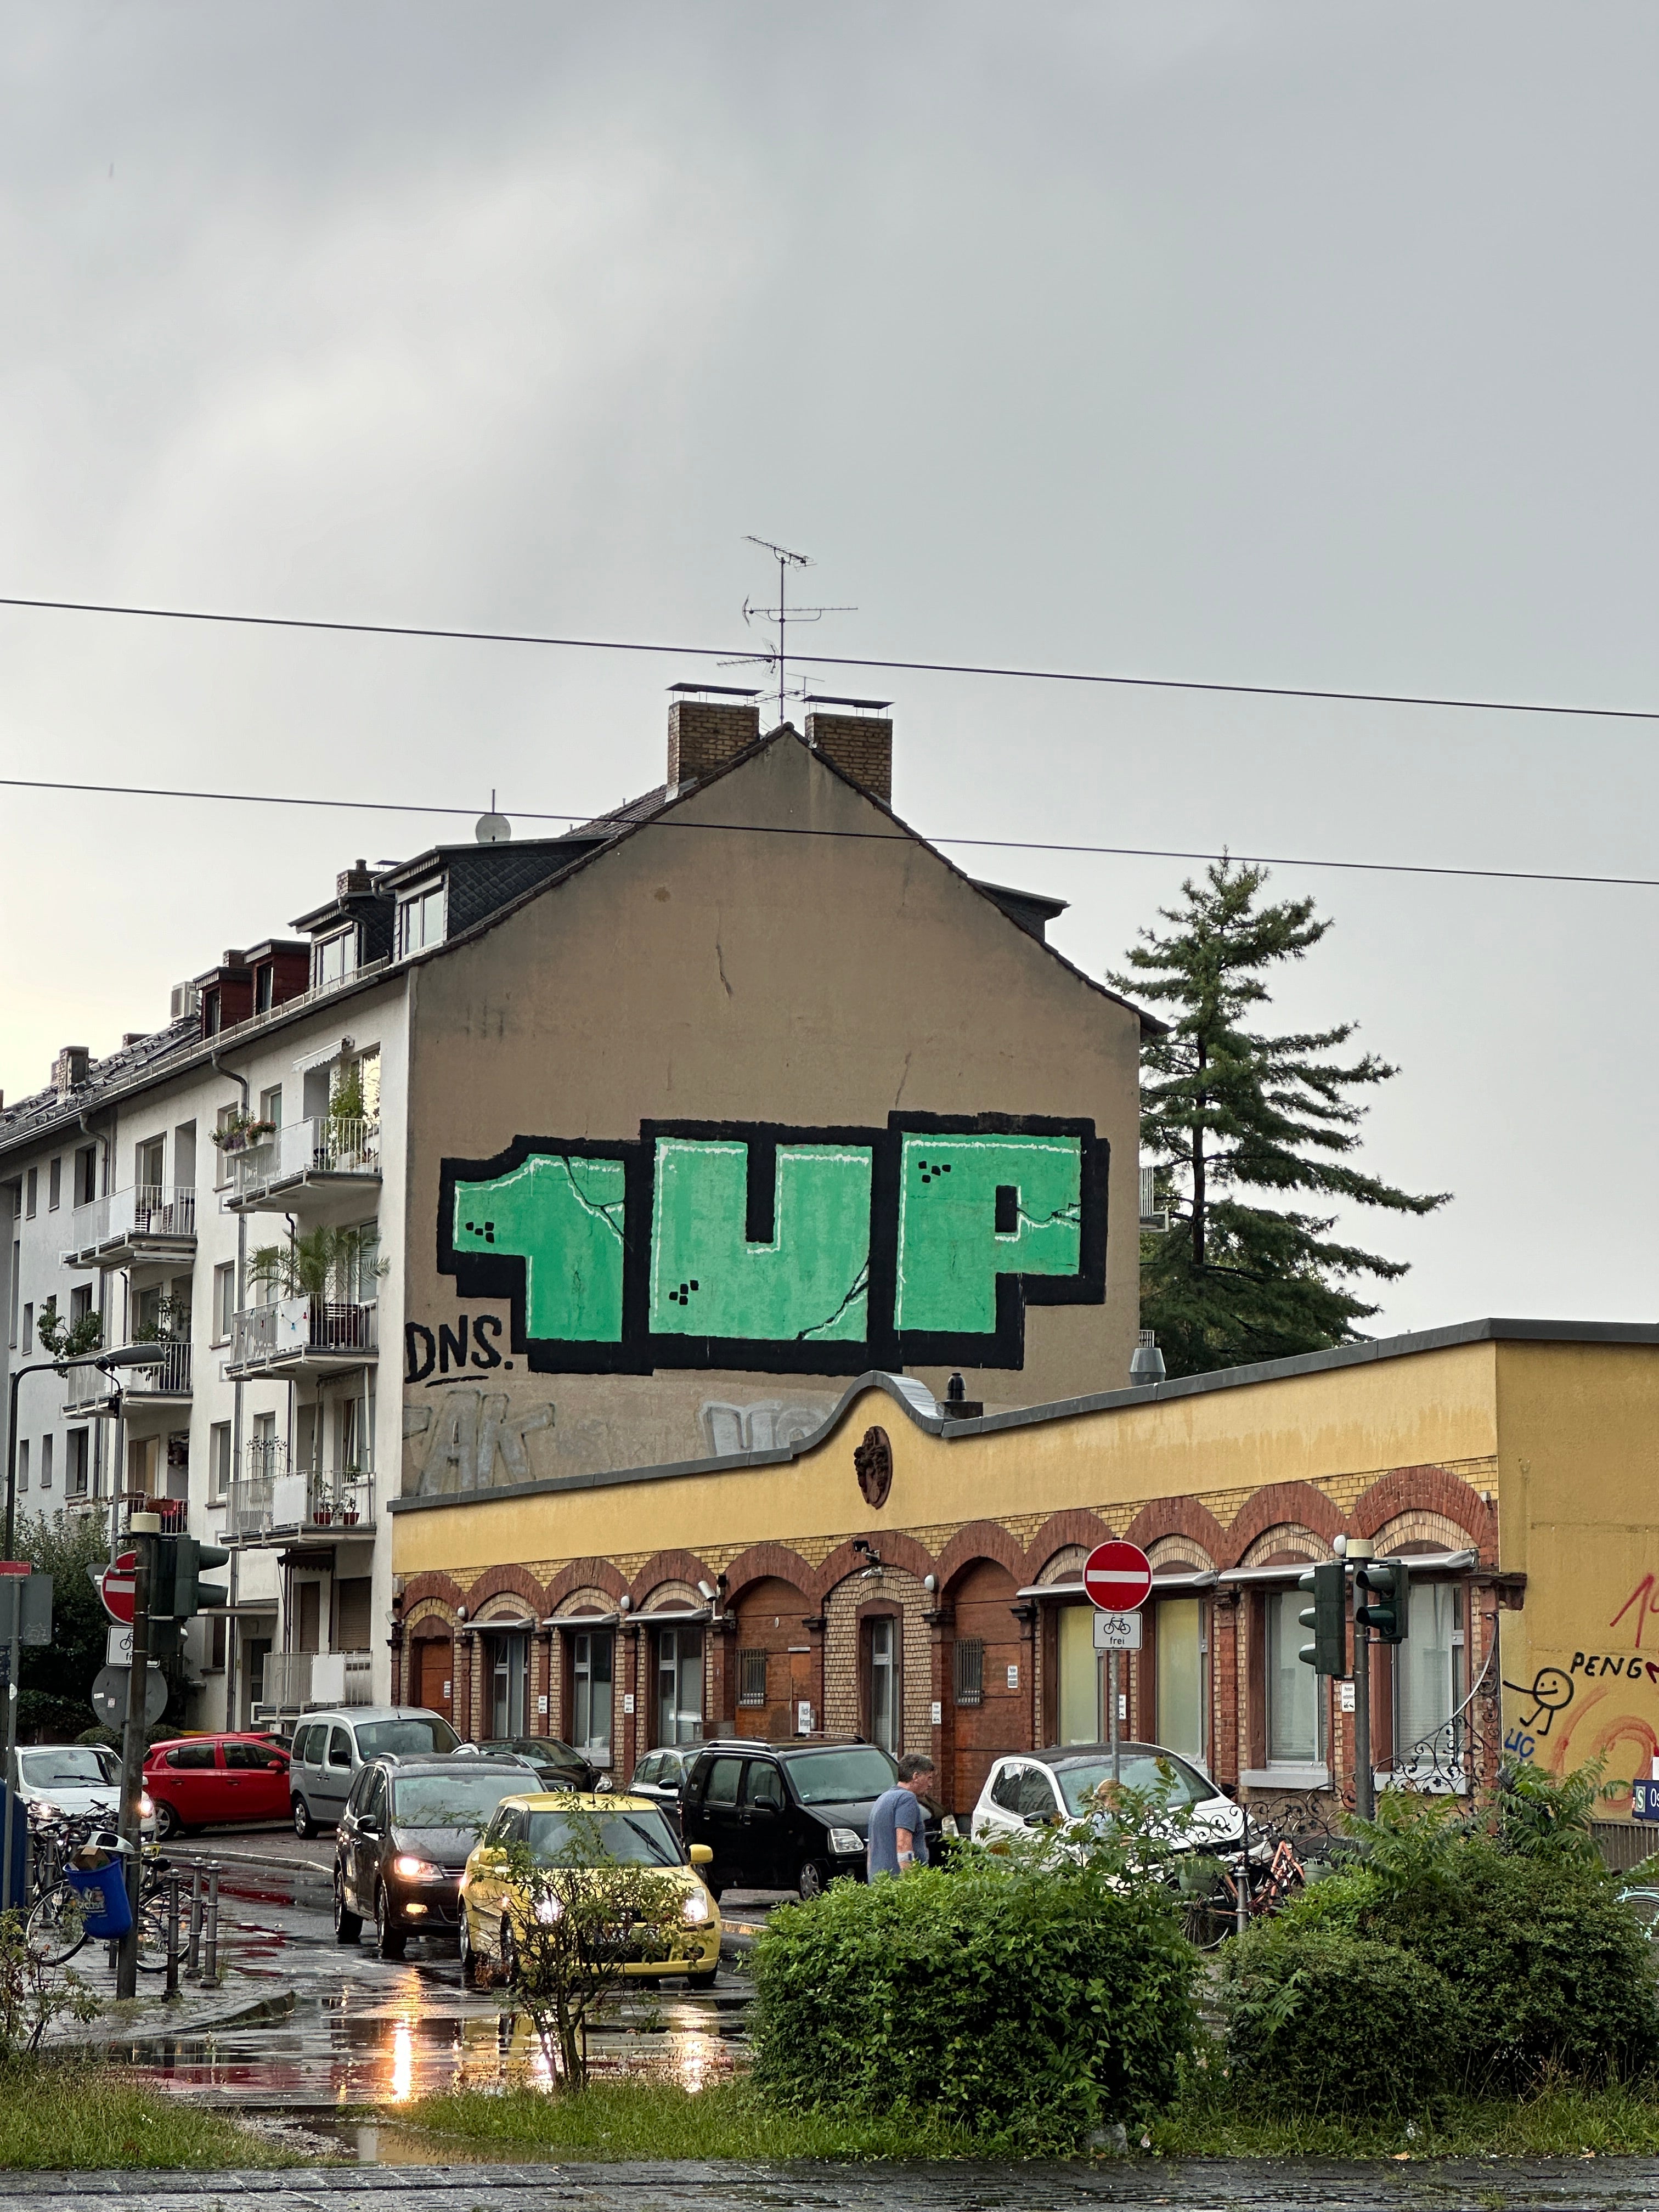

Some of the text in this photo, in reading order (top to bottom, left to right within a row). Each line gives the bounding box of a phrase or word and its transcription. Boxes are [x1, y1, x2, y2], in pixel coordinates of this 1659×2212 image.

[437, 1111, 1109, 1375] 1UP
[405, 1315, 513, 1384] DNS.
[1110, 1637, 1125, 1645] frei
[1570, 1652, 1643, 1679] PENG
